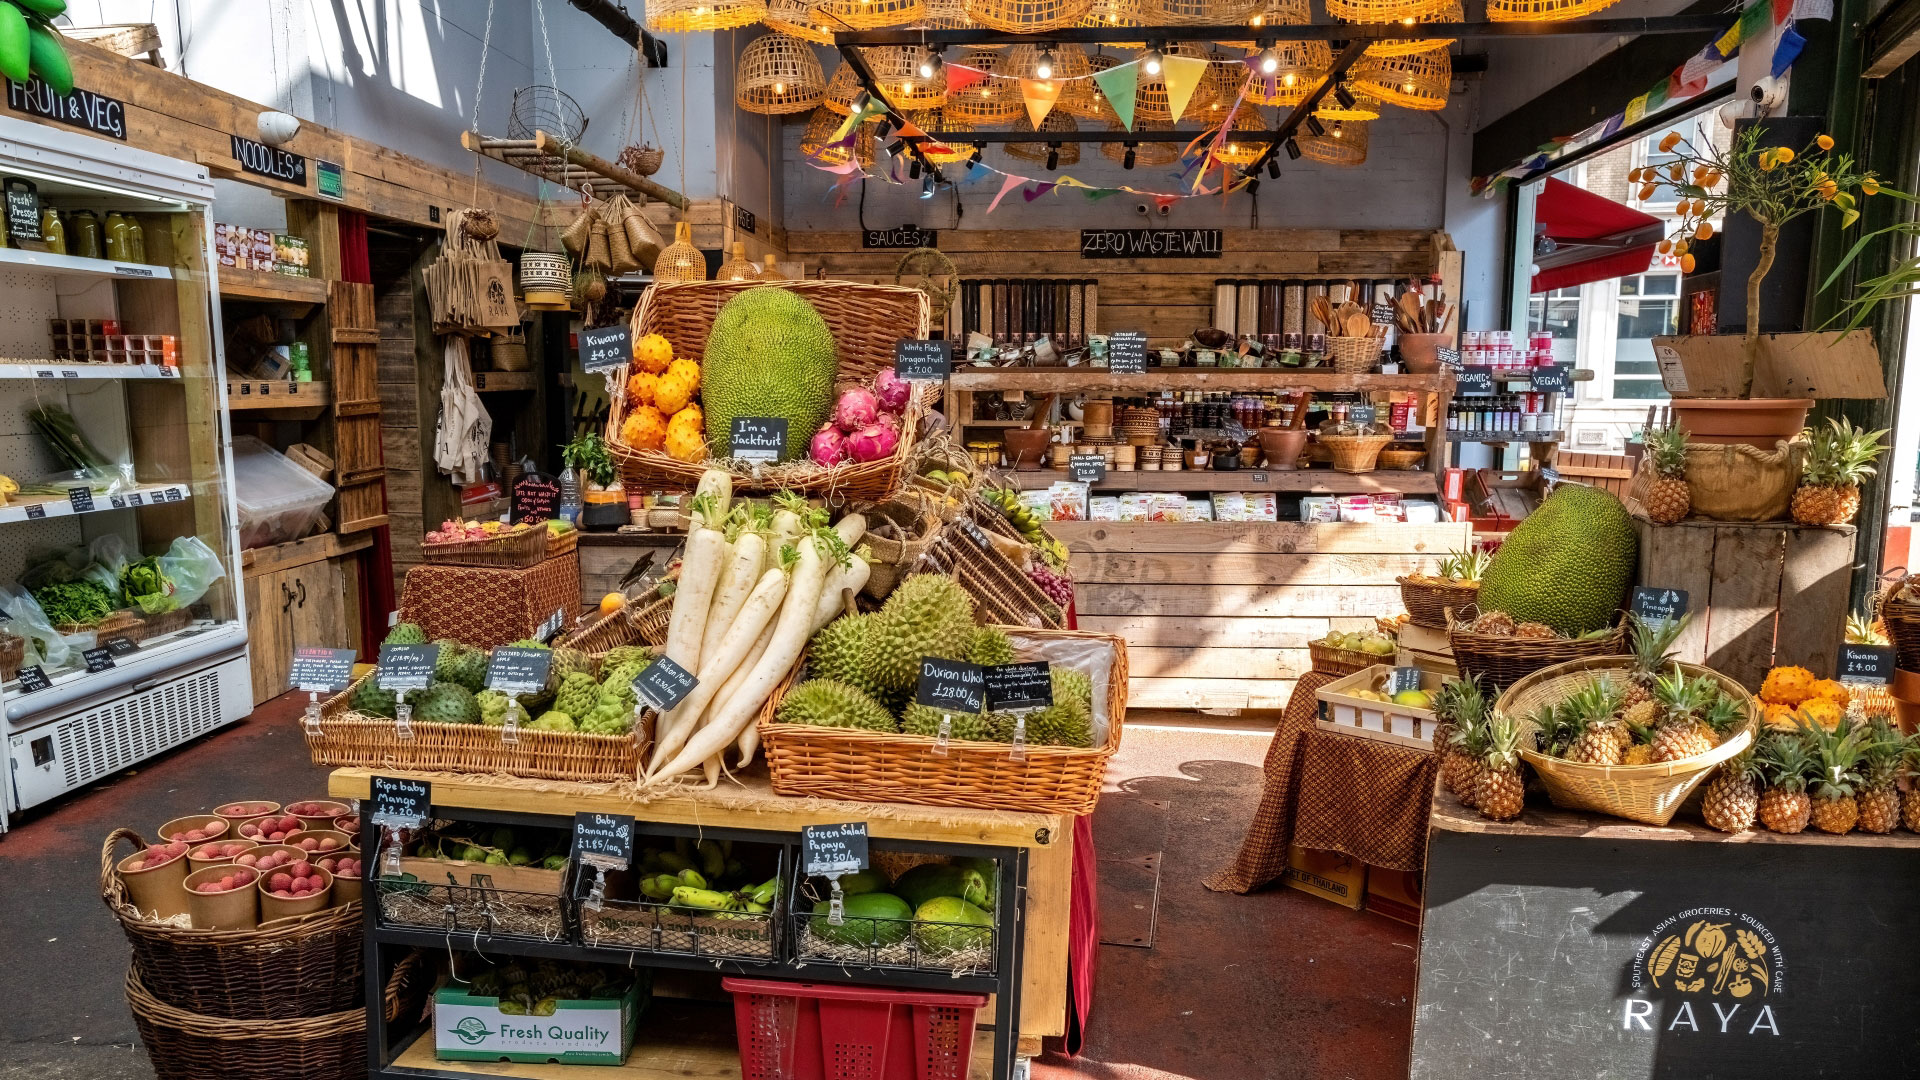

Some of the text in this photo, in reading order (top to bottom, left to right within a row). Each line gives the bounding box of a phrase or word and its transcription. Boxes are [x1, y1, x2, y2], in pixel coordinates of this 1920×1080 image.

[69, 96, 81, 119] &
[80, 91, 122, 137] VEG
[235, 138, 294, 179] NOODLES
[8, 191, 30, 207] Fresh
[12, 204, 38, 219] Pressed
[870, 231, 920, 246] SAUCES
[1082, 230, 1222, 254] ZERO WASTE WALL
[488, 304, 509, 317] RAYA
[586, 332, 625, 347] Kiwano
[591, 347, 620, 361] £4.00
[903, 343, 941, 352] White Flesh
[899, 353, 943, 365] Dragon Fruit
[1456, 373, 1486, 383] ORGANIC
[1533, 375, 1562, 386] VEGAN
[739, 419, 758, 433] I'm
[731, 431, 781, 446] Jackfruit
[1077, 468, 1096, 476] £15.00
[1254, 524, 1280, 534] MAX
[1638, 592, 1655, 601] Mini
[1642, 601, 1675, 613] Pineapple
[1846, 649, 1878, 661] Kiwano
[657, 658, 677, 678] Daikon
[924, 663, 959, 681] Durian
[1847, 661, 1877, 672] £4.00
[932, 682, 980, 708] £28.00/kg
[376, 778, 425, 796] Ripe baby
[377, 793, 416, 809] Mango
[595, 815, 616, 828] Baby
[578, 824, 615, 837] Banana
[807, 823, 866, 839] Green Salad
[578, 839, 622, 856] £1.85/100g
[809, 840, 845, 853] Papaya
[1302, 873, 1311, 882] OF
[1313, 876, 1346, 895] THAILAND
[1631, 907, 1783, 994] SOUTHEAST ASIAN GROCERIES SOURCED WITH CARE
[1623, 998, 1780, 1036] RAYA
[500, 1024, 609, 1045] Fresh Quality
